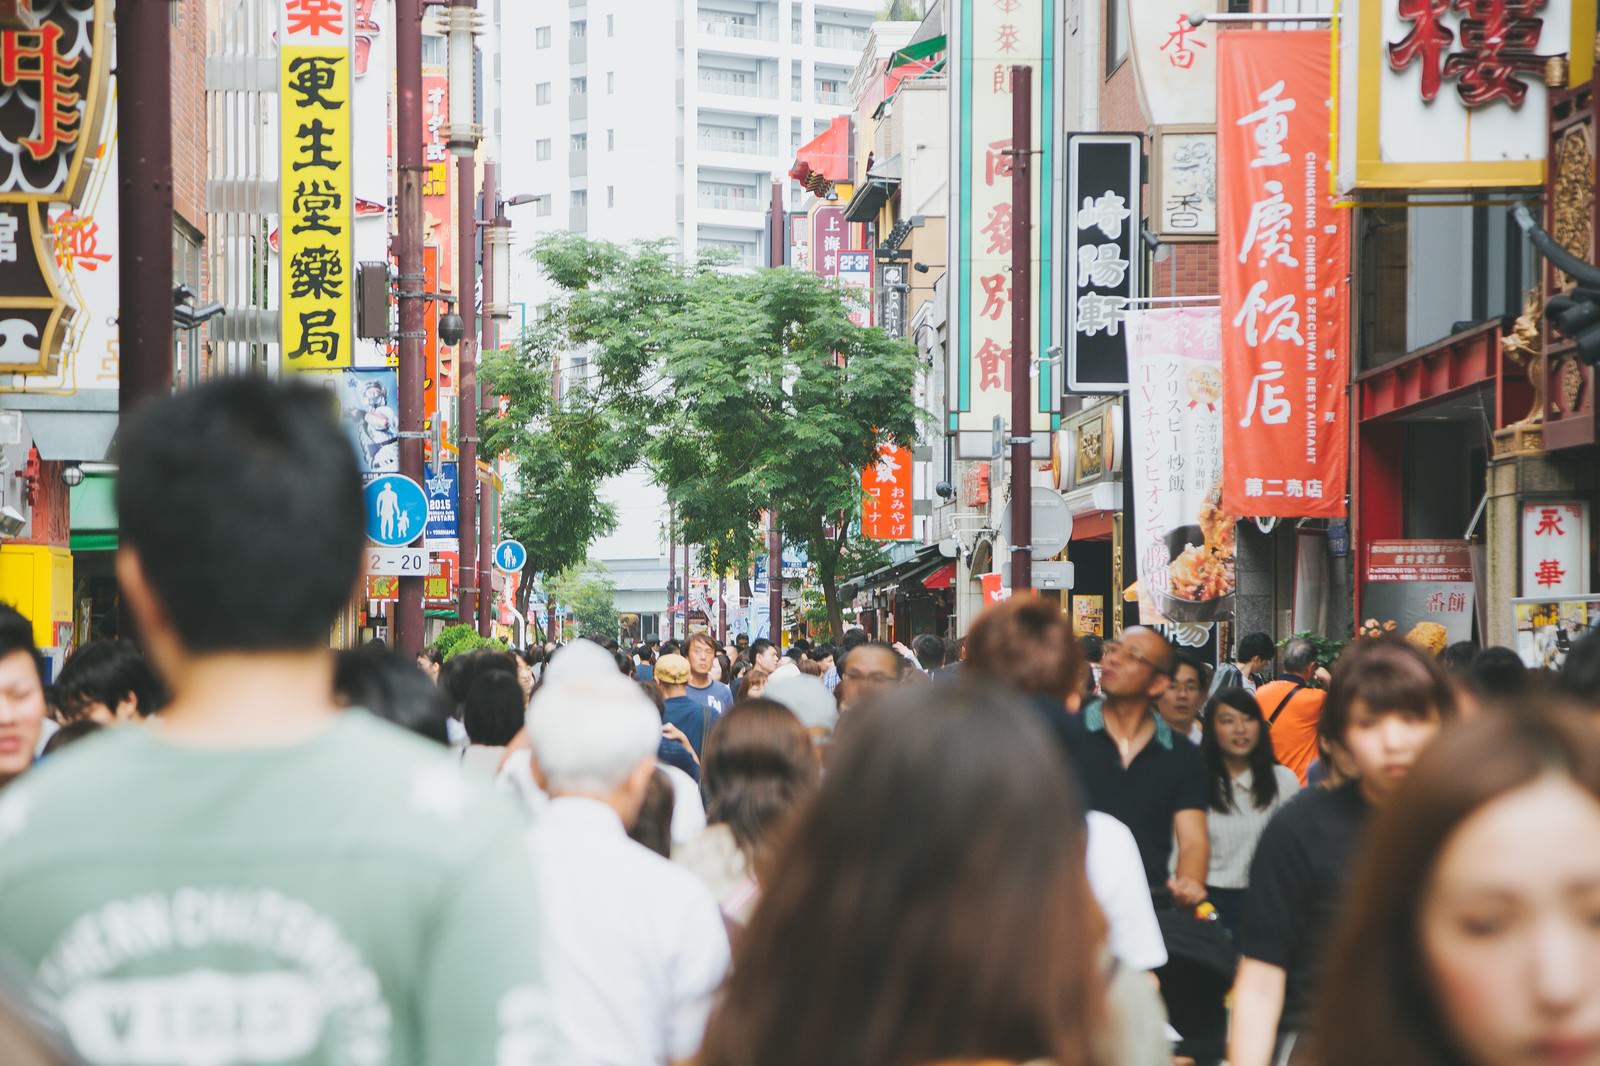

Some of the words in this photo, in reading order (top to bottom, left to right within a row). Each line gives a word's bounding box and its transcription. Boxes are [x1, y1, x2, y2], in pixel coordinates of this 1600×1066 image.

[1304, 151, 1317, 229] CHUNGKING
[1076, 190, 1132, 336] 崎陽軒
[1304, 234, 1317, 291] CHINESE
[1305, 296, 1318, 372] SZECHWAN
[1305, 376, 1318, 465] RESTAURANT
[429, 499, 451, 510] 2015
[1244, 477, 1323, 498] 第二売店
